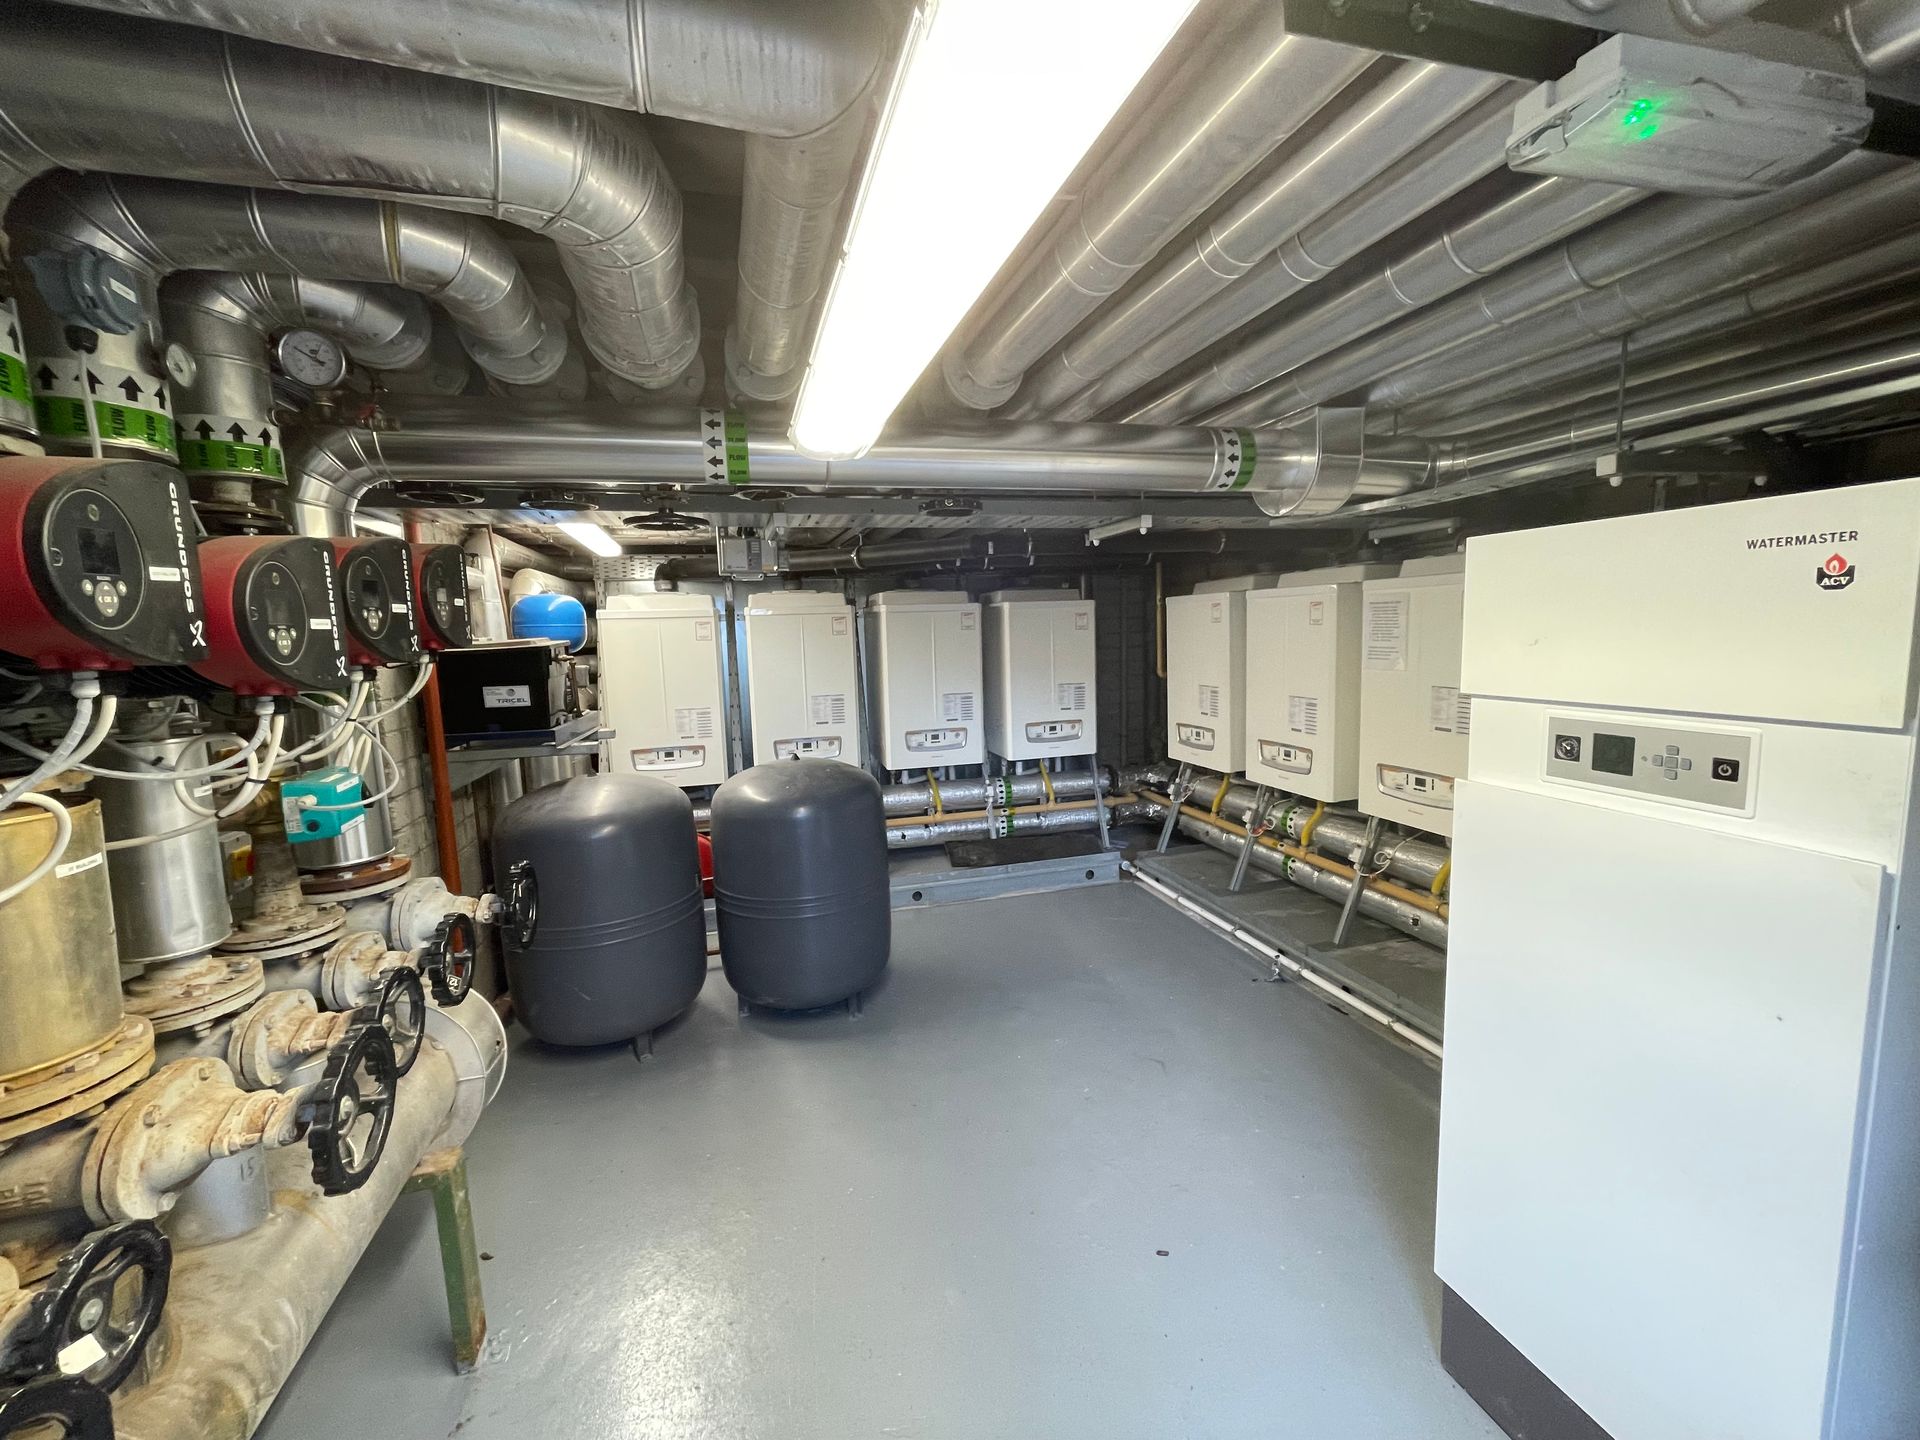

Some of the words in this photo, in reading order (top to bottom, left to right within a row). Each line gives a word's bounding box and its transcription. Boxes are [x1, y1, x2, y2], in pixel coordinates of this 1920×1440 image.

[71, 402, 89, 432] FLOW
[110, 407, 125, 436] FLOW
[145, 414, 157, 443] FLOW
[225, 445, 238, 468] FLOW
[253, 449, 264, 471] FLOW
[169, 482, 194, 613] GRUNDFOS
[1746, 530, 1859, 550] WATERMASTER
[401, 549, 414, 631] GRUNDFOS
[1820, 576, 1850, 586] ACV
[323, 551, 340, 651] GRUNDFOS
[495, 697, 528, 705] TRICEL
